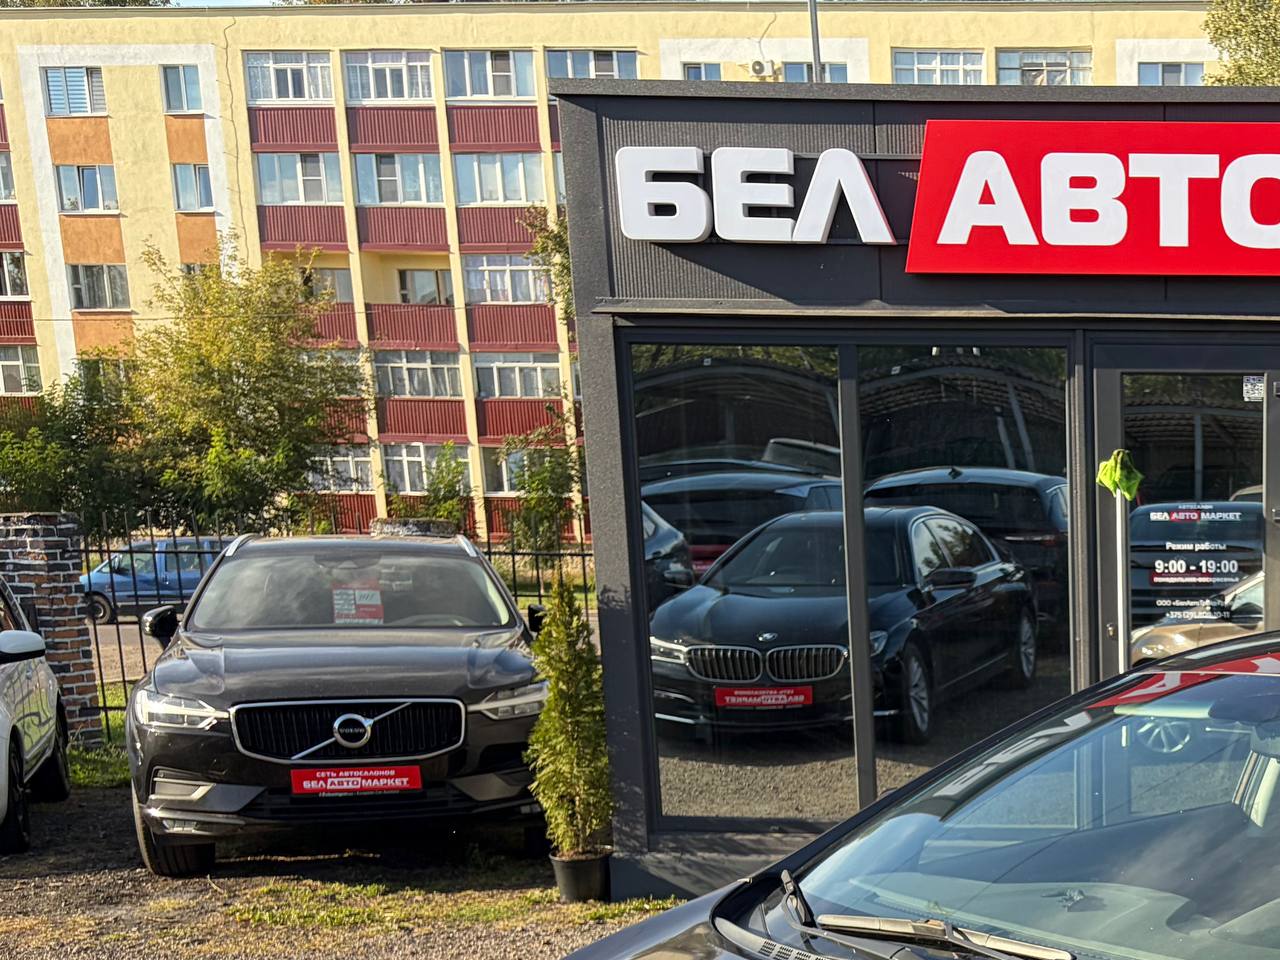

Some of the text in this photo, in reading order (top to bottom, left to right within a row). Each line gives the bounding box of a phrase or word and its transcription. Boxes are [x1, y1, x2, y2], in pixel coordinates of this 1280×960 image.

[614, 146, 897, 245] БЕЛ
[1171, 512, 1199, 520] АВТО
[1201, 512, 1242, 521] МАРКЕТ
[1165, 541, 1227, 552] Режим работы
[1154, 560, 1186, 573] 9:00
[1199, 560, 1238, 573] 19:00
[315, 769, 396, 778] СЕТЬ АВТОСАЛОНОВ
[302, 777, 409, 789] БЕЛ АВТО МАРКЕТ
